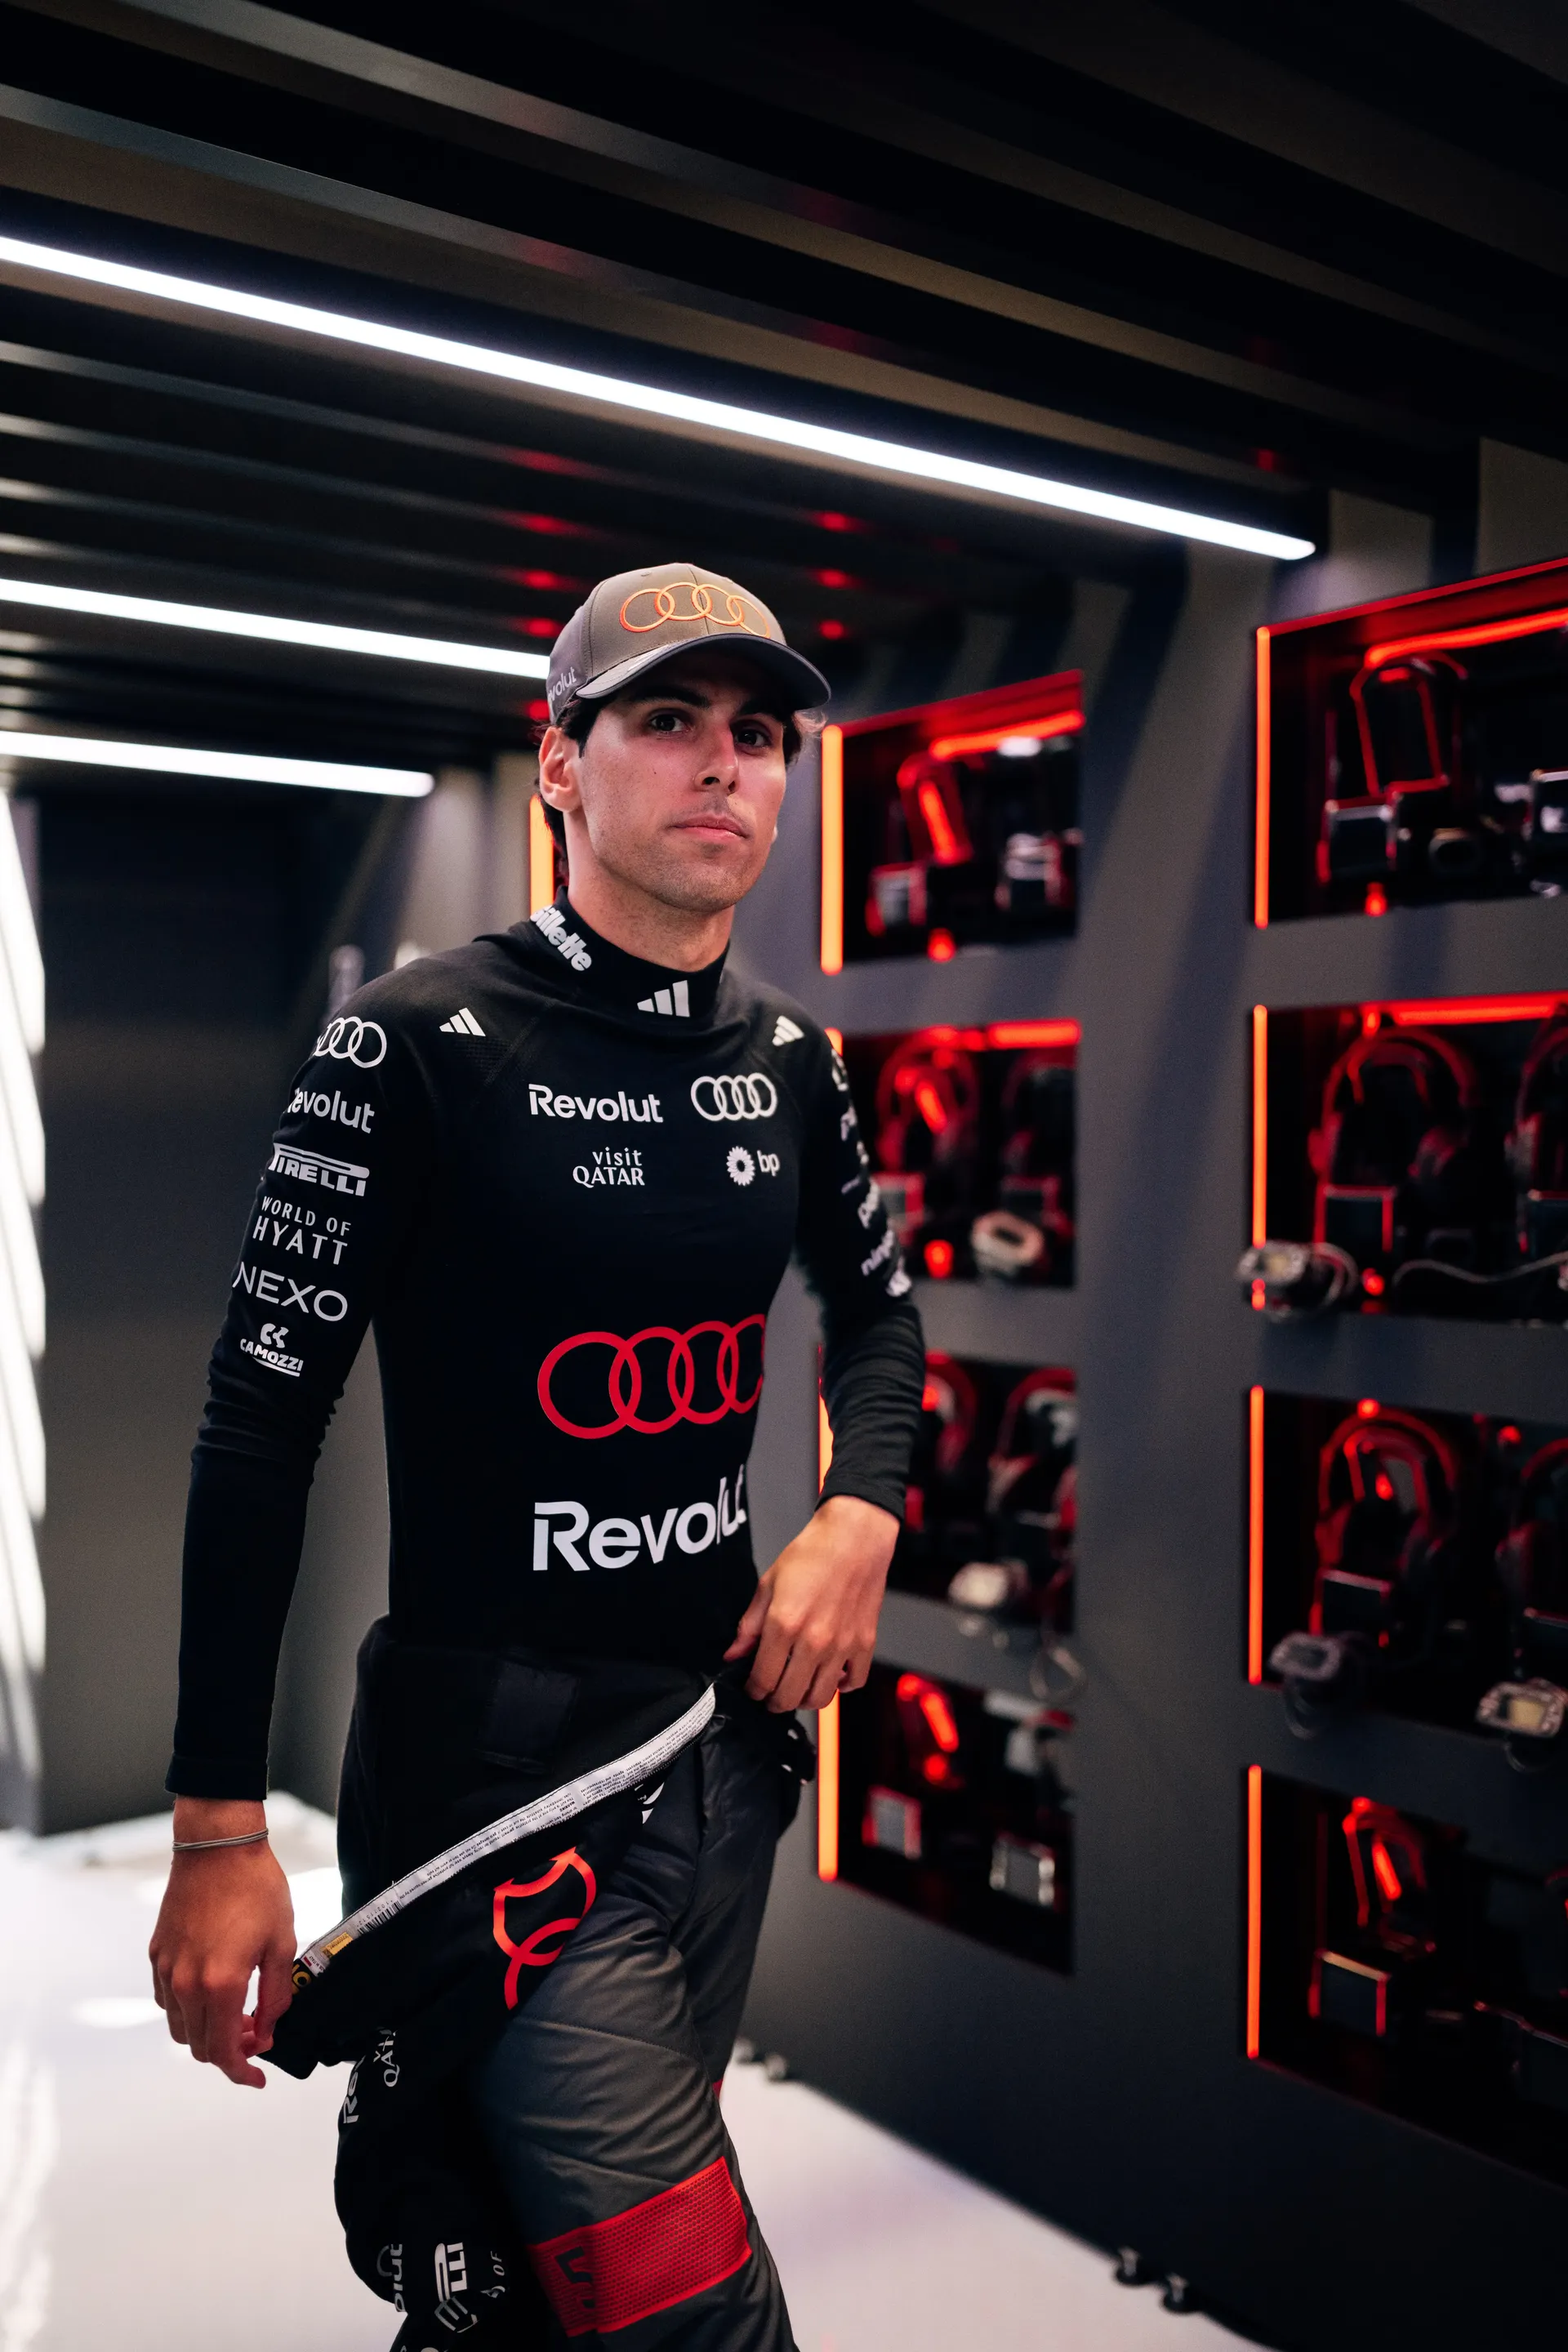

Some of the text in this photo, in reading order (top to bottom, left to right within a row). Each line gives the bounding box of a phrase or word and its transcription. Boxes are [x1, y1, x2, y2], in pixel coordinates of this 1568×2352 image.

[549, 666, 577, 702] volut
[528, 1083, 664, 1123] Revolut
[268, 1143, 370, 1197] PIRELLI
[592, 1147, 642, 1166] visit
[757, 1150, 780, 1176] bp
[572, 1165, 645, 1188] QATAR
[261, 1196, 352, 1236] WORLD OF
[252, 1215, 348, 1265] HYATT
[232, 1261, 348, 1321] NEXO
[240, 1338, 304, 1372] CAMOZZI
